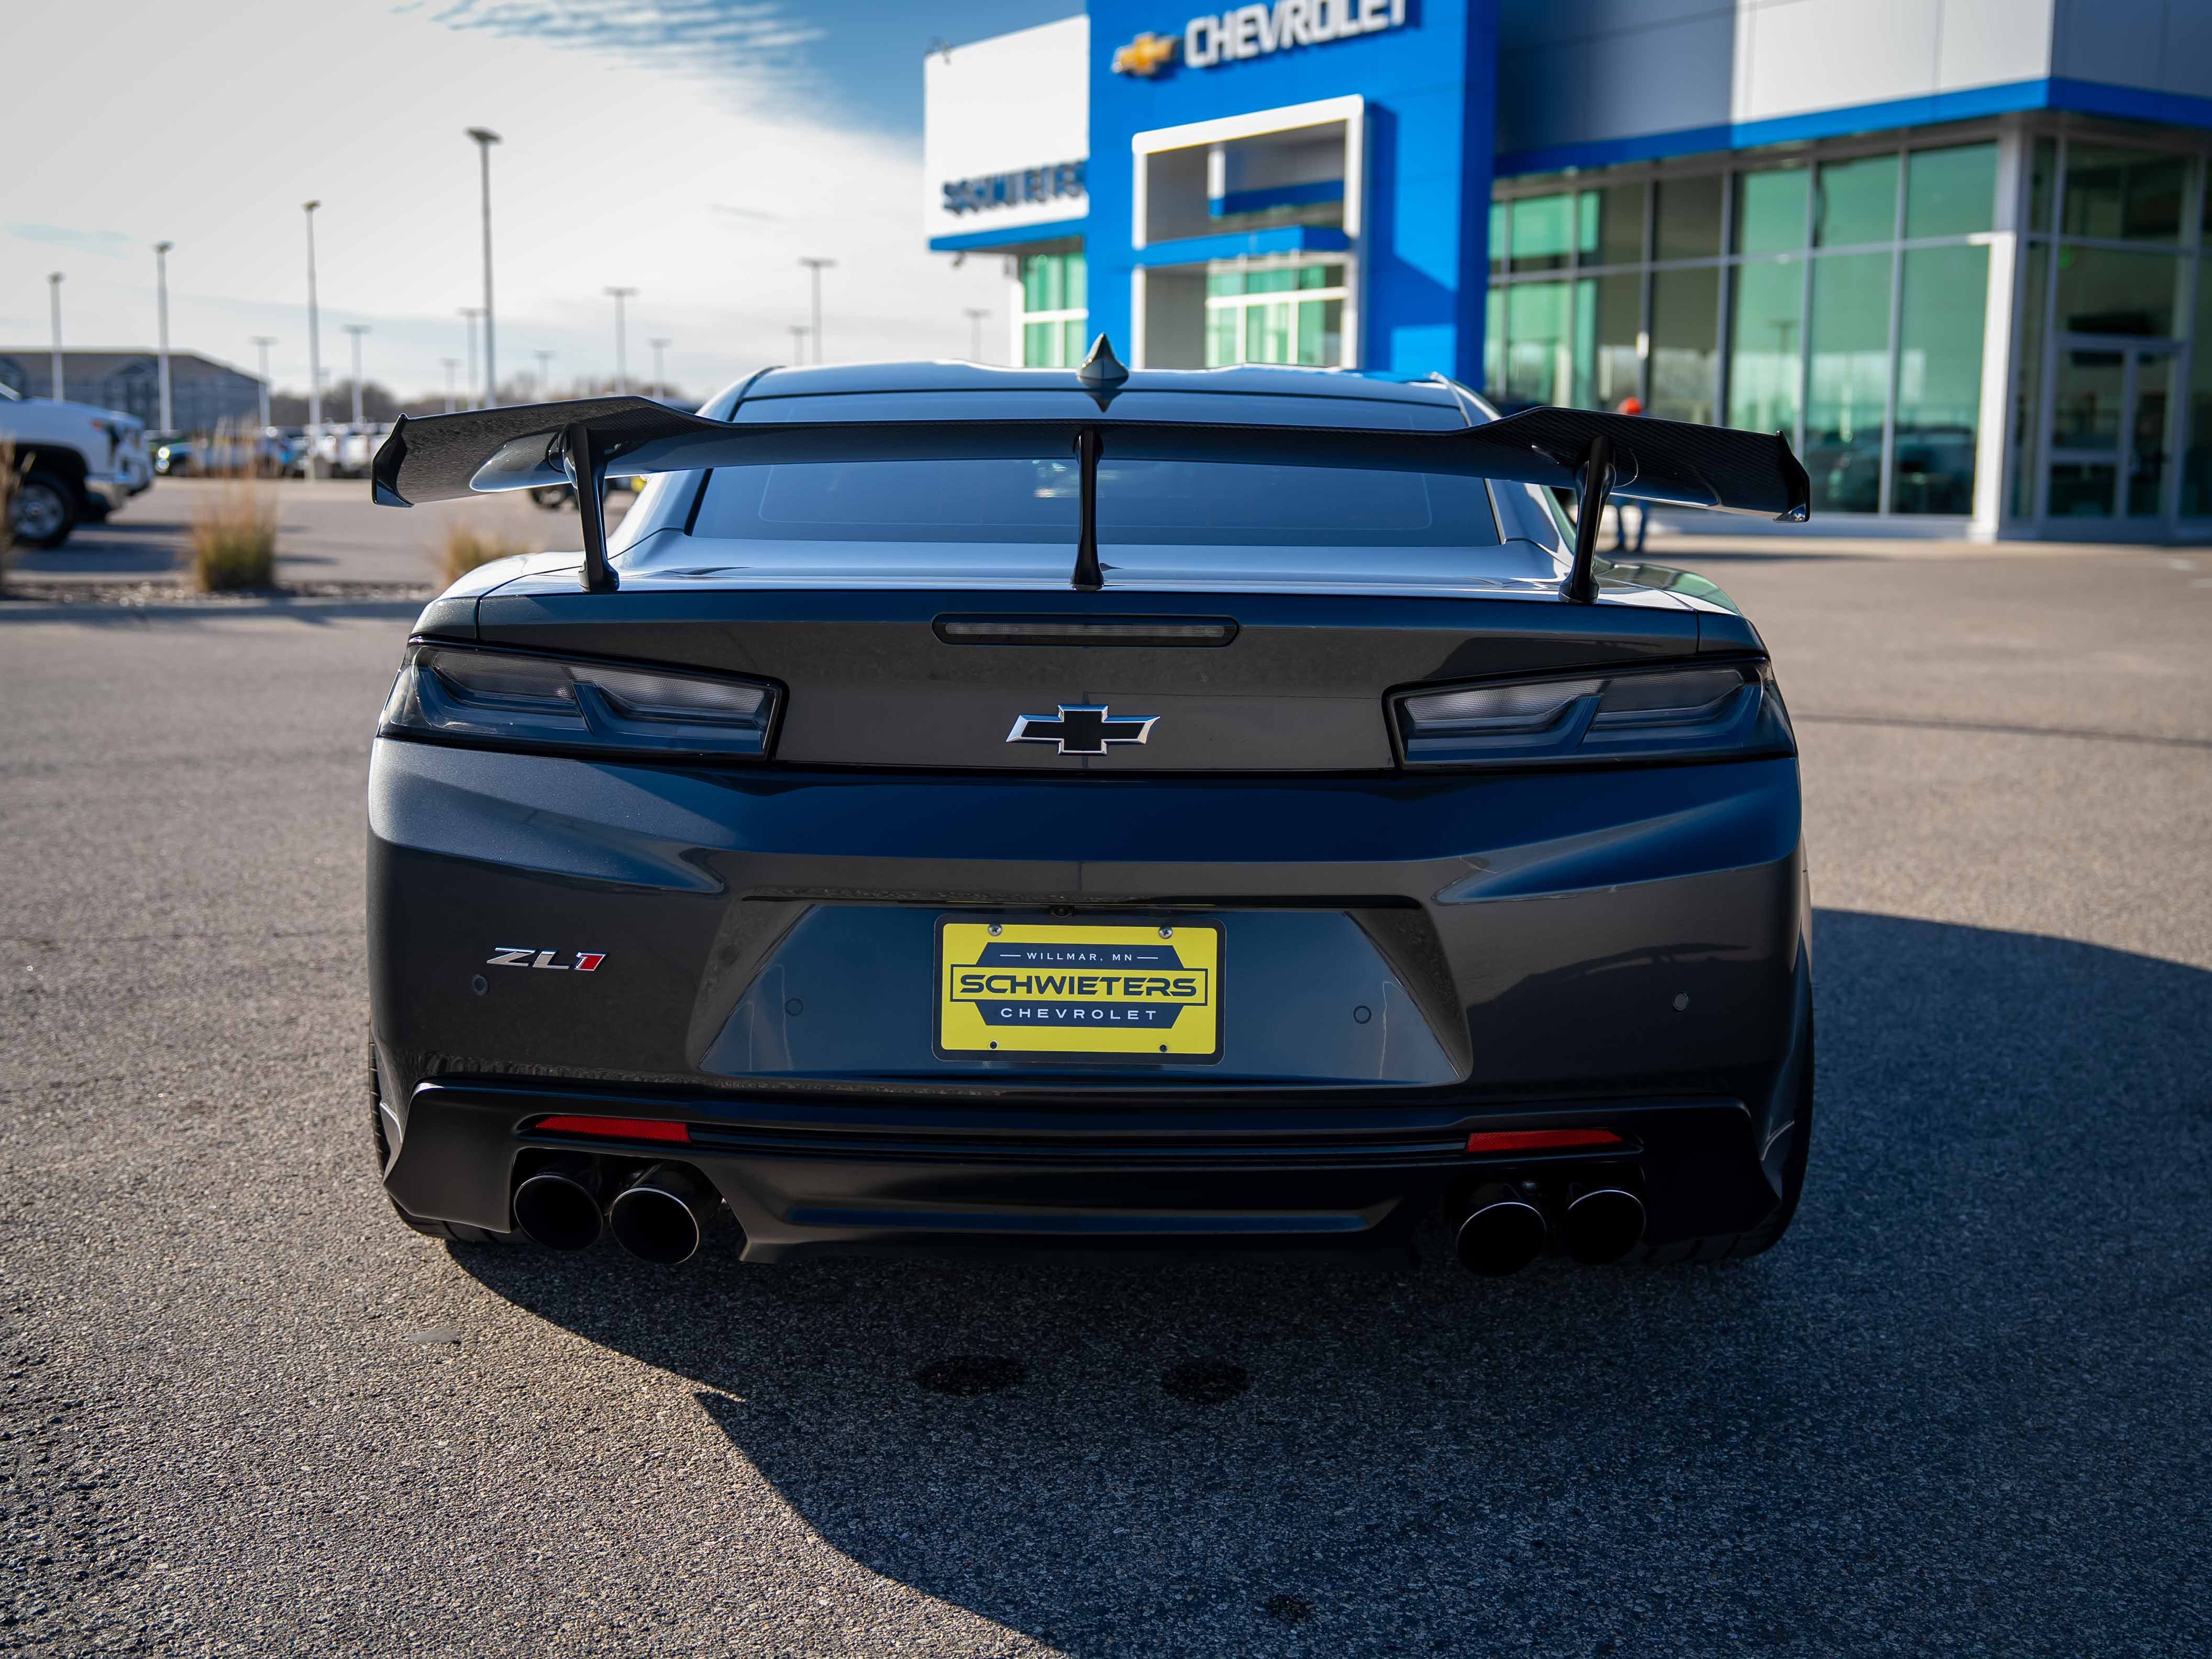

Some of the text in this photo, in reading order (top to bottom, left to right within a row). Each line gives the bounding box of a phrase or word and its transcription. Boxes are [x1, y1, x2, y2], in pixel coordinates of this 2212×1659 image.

[487, 947, 607, 971] ZL1
[1027, 953, 1104, 961] WILLMAR,
[960, 974, 1197, 996] SCHWIETERS
[1001, 1008, 1157, 1021] CHEVROLET
